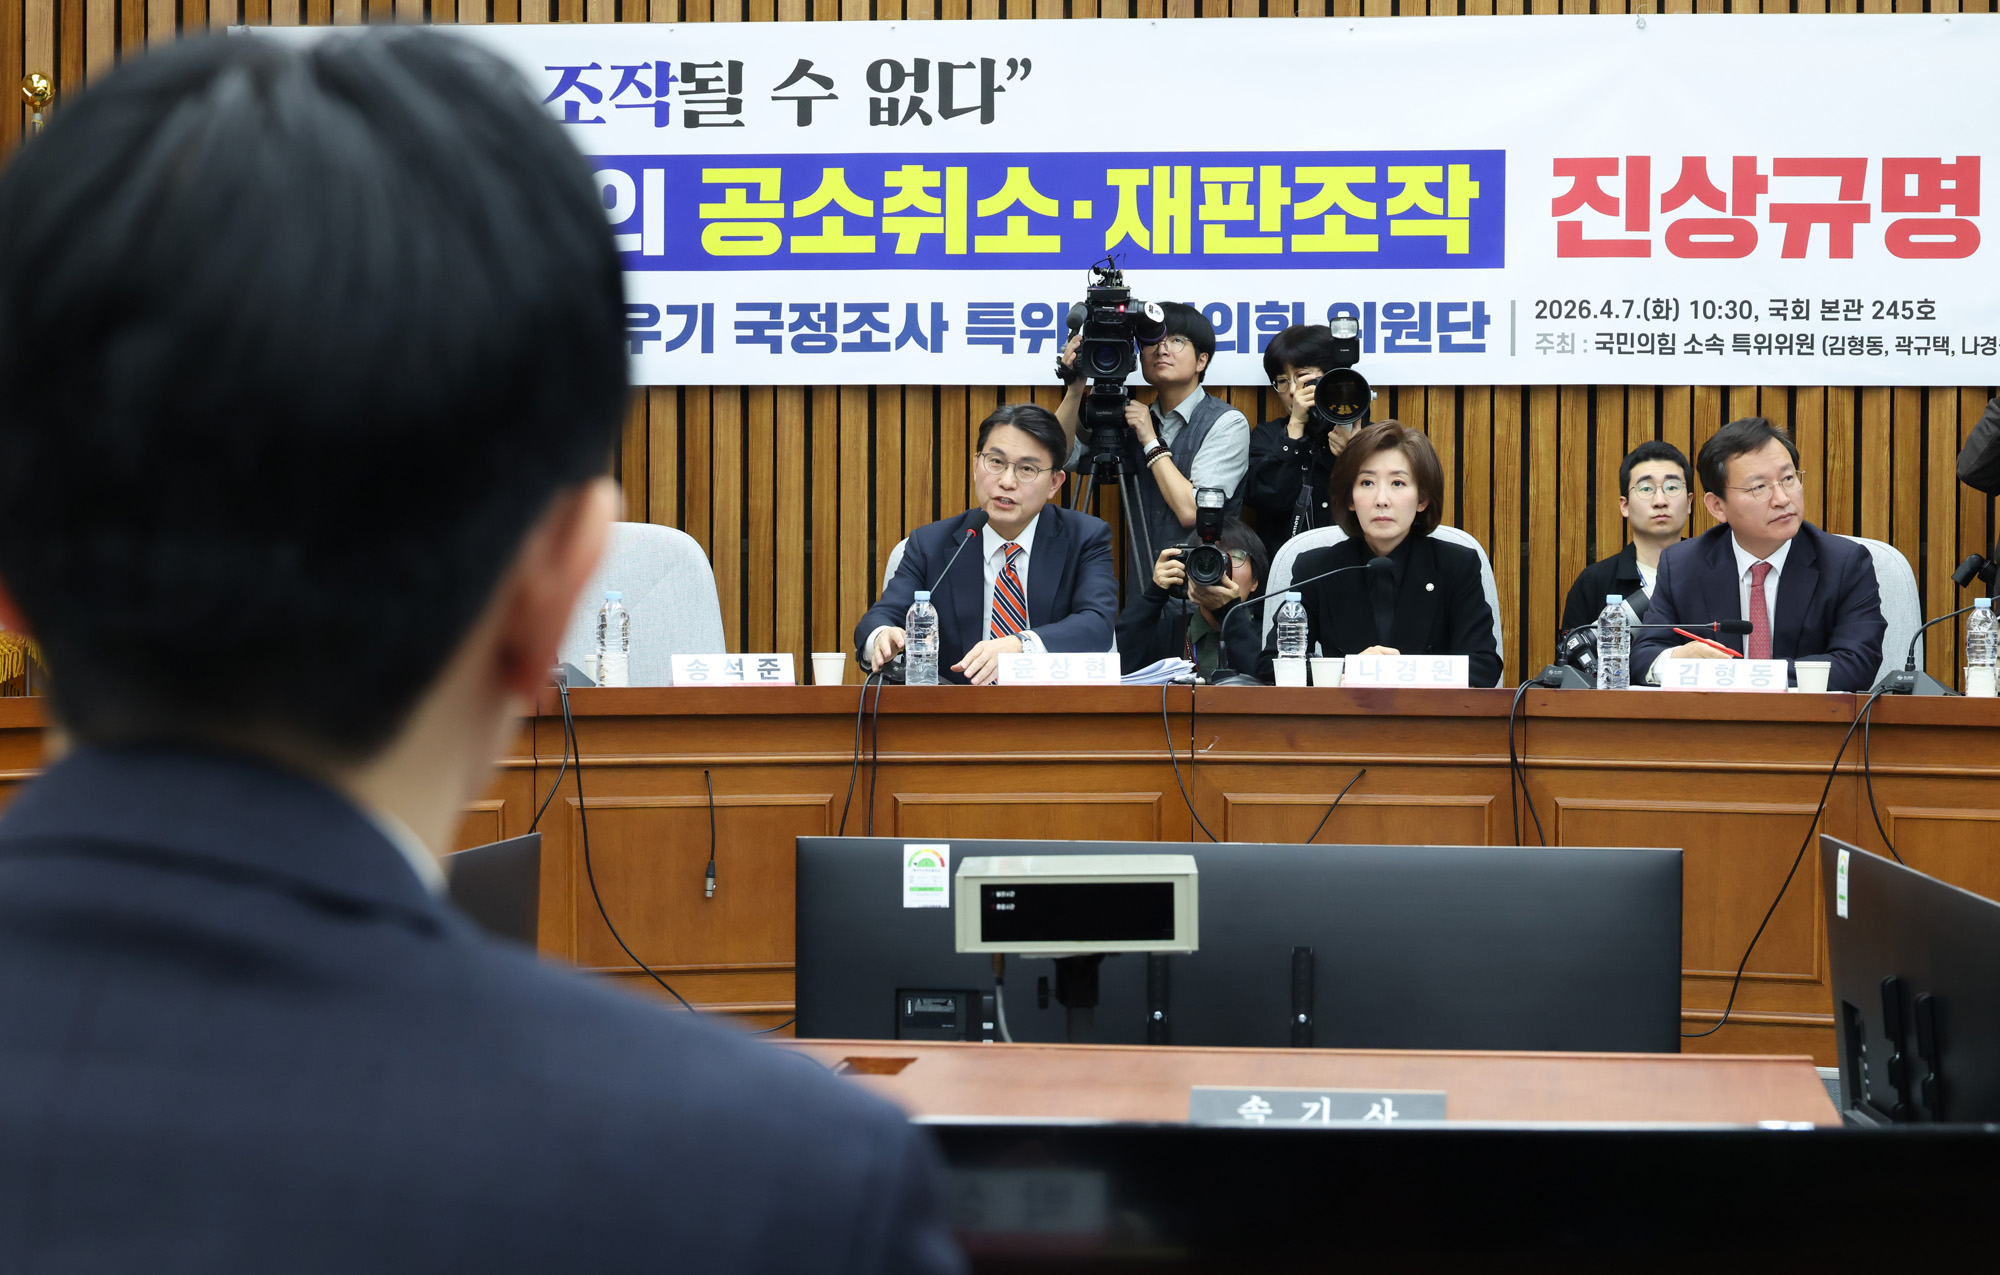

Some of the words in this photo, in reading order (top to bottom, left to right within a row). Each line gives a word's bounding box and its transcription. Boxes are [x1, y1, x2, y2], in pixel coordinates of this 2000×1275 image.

[543, 60, 745, 128] 조작될
[771, 59, 838, 127] 수
[866, 57, 1032, 127] 없다”
[699, 163, 1480, 256] 공소취소·재판조작
[1551, 155, 1982, 260] 진상규명
[1534, 299, 1680, 323] 2026.4.7.(화)
[1689, 299, 1759, 323] 10:30,
[1768, 298, 1810, 322] 국회
[1819, 298, 1865, 322] 본관
[1871, 298, 1937, 322] 245호
[734, 301, 950, 355] 국정조사
[965, 301, 1070, 354] 특위
[1535, 332, 1575, 355] 주최
[1595, 332, 1676, 355] 국민의힘
[1684, 333, 1725, 356] 소속
[1731, 333, 1815, 356] 특위위원
[1822, 335, 1889, 357] (김형동,
[1895, 335, 1956, 357] 곽규택,
[1961, 335, 2000, 356] 나경
[685, 657, 781, 681] 송석준
[1011, 657, 1107, 680] 윤상현
[1358, 659, 1454, 682] 나경원
[1678, 663, 1774, 688] 김형동
[1237, 1094, 1400, 1126] 속기사
